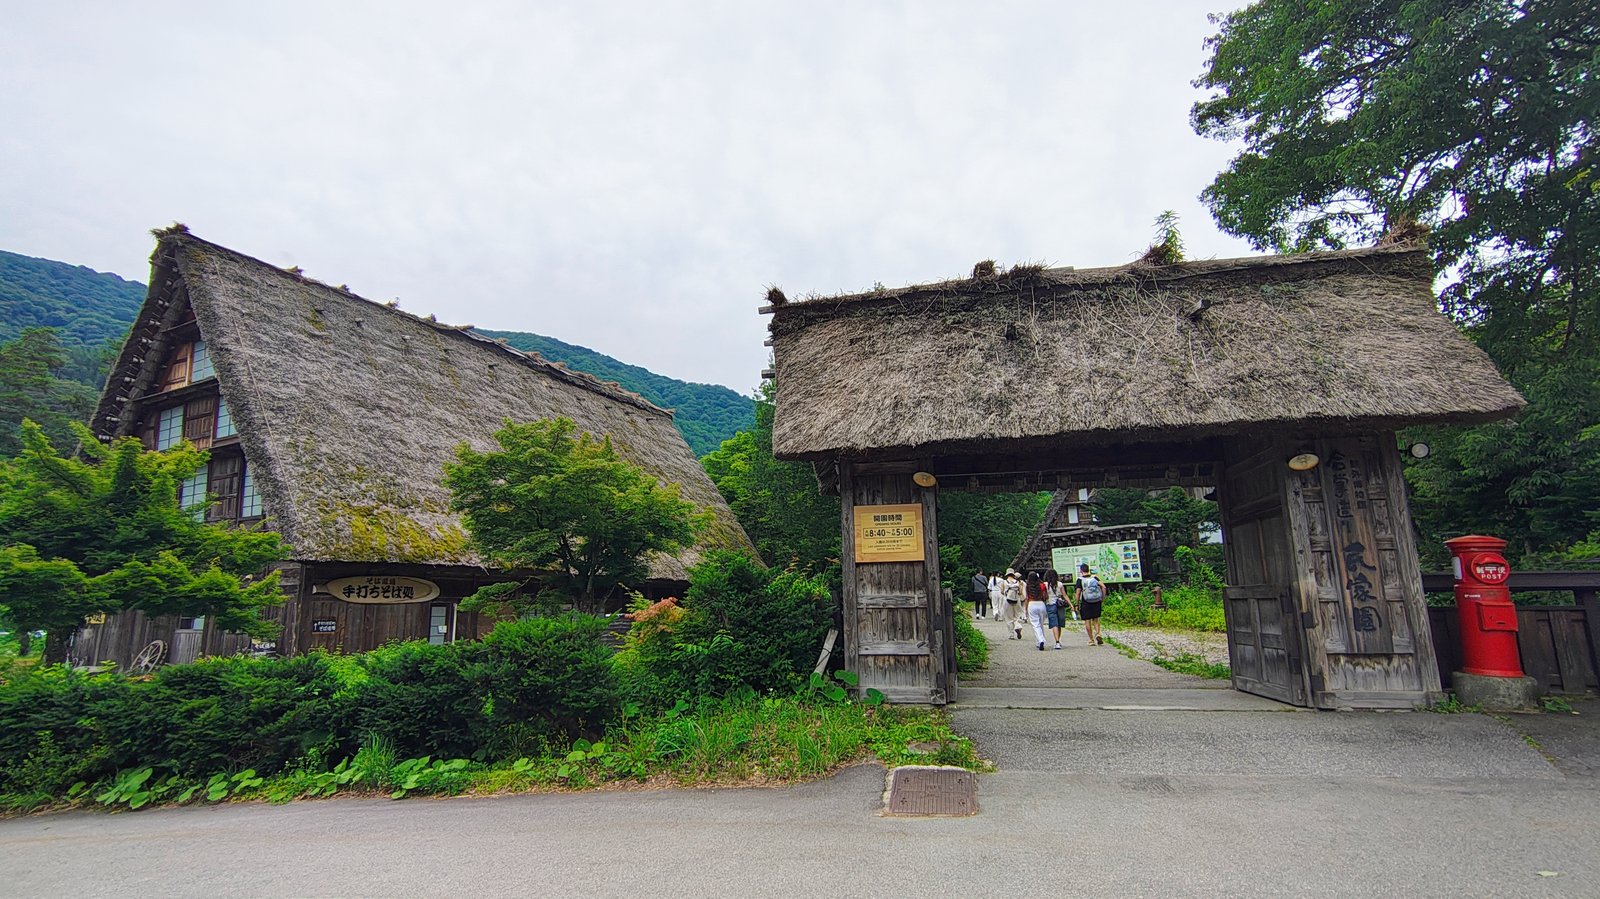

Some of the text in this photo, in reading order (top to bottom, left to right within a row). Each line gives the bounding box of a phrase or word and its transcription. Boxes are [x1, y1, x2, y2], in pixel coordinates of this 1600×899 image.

[873, 514, 902, 522] 開園時間
[869, 529, 886, 537] 8:40
[896, 528, 913, 536] 5:00
[342, 585, 415, 599] 手打ちそば処
